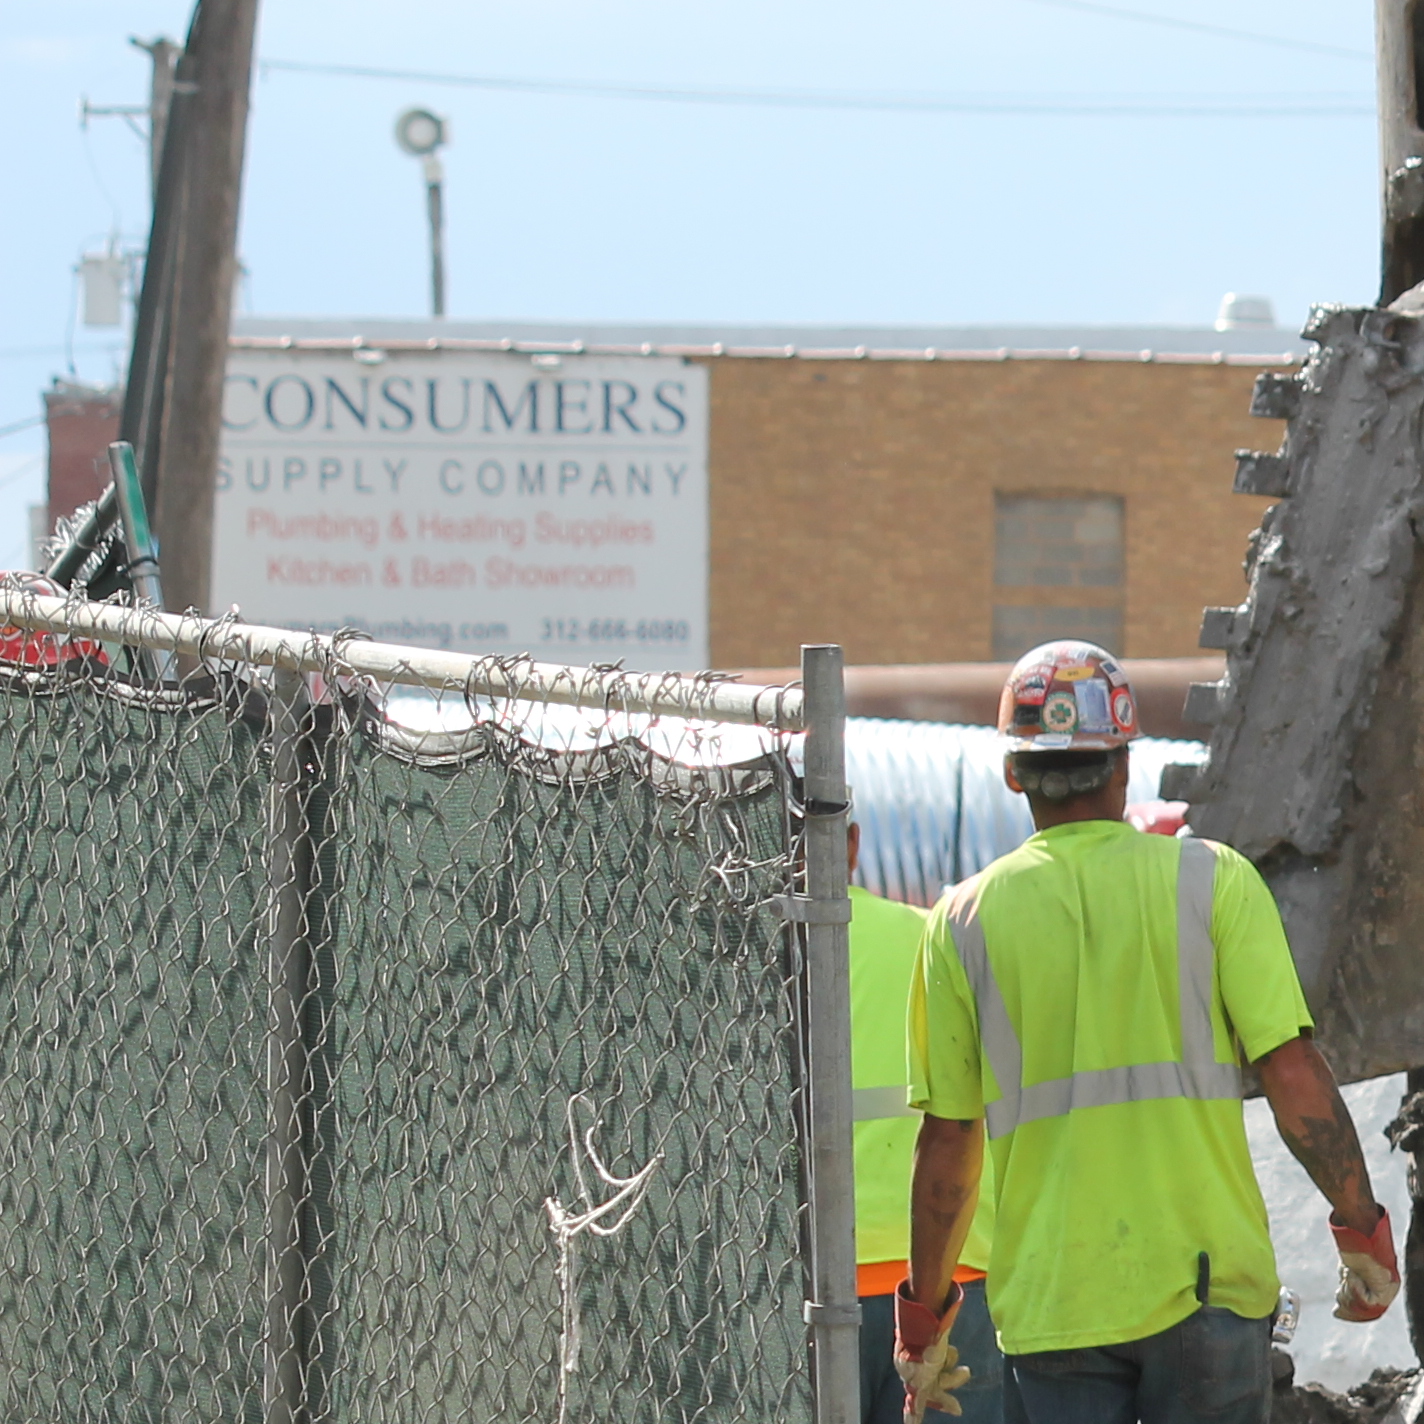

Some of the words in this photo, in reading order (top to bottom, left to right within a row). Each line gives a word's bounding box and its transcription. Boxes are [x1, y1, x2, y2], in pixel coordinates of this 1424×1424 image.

[222, 375, 687, 434] CONSUMERS
[217, 457, 407, 492] SUPPLY
[440, 459, 688, 495] COMPANY
[247, 509, 379, 550] Plumbing
[387, 511, 407, 542] &
[417, 513, 525, 550] Heating
[534, 511, 654, 547] Supplies
[266, 557, 372, 584] Kitchen
[382, 557, 402, 586] &
[411, 556, 475, 588] Bath
[484, 556, 634, 589] Showroom
